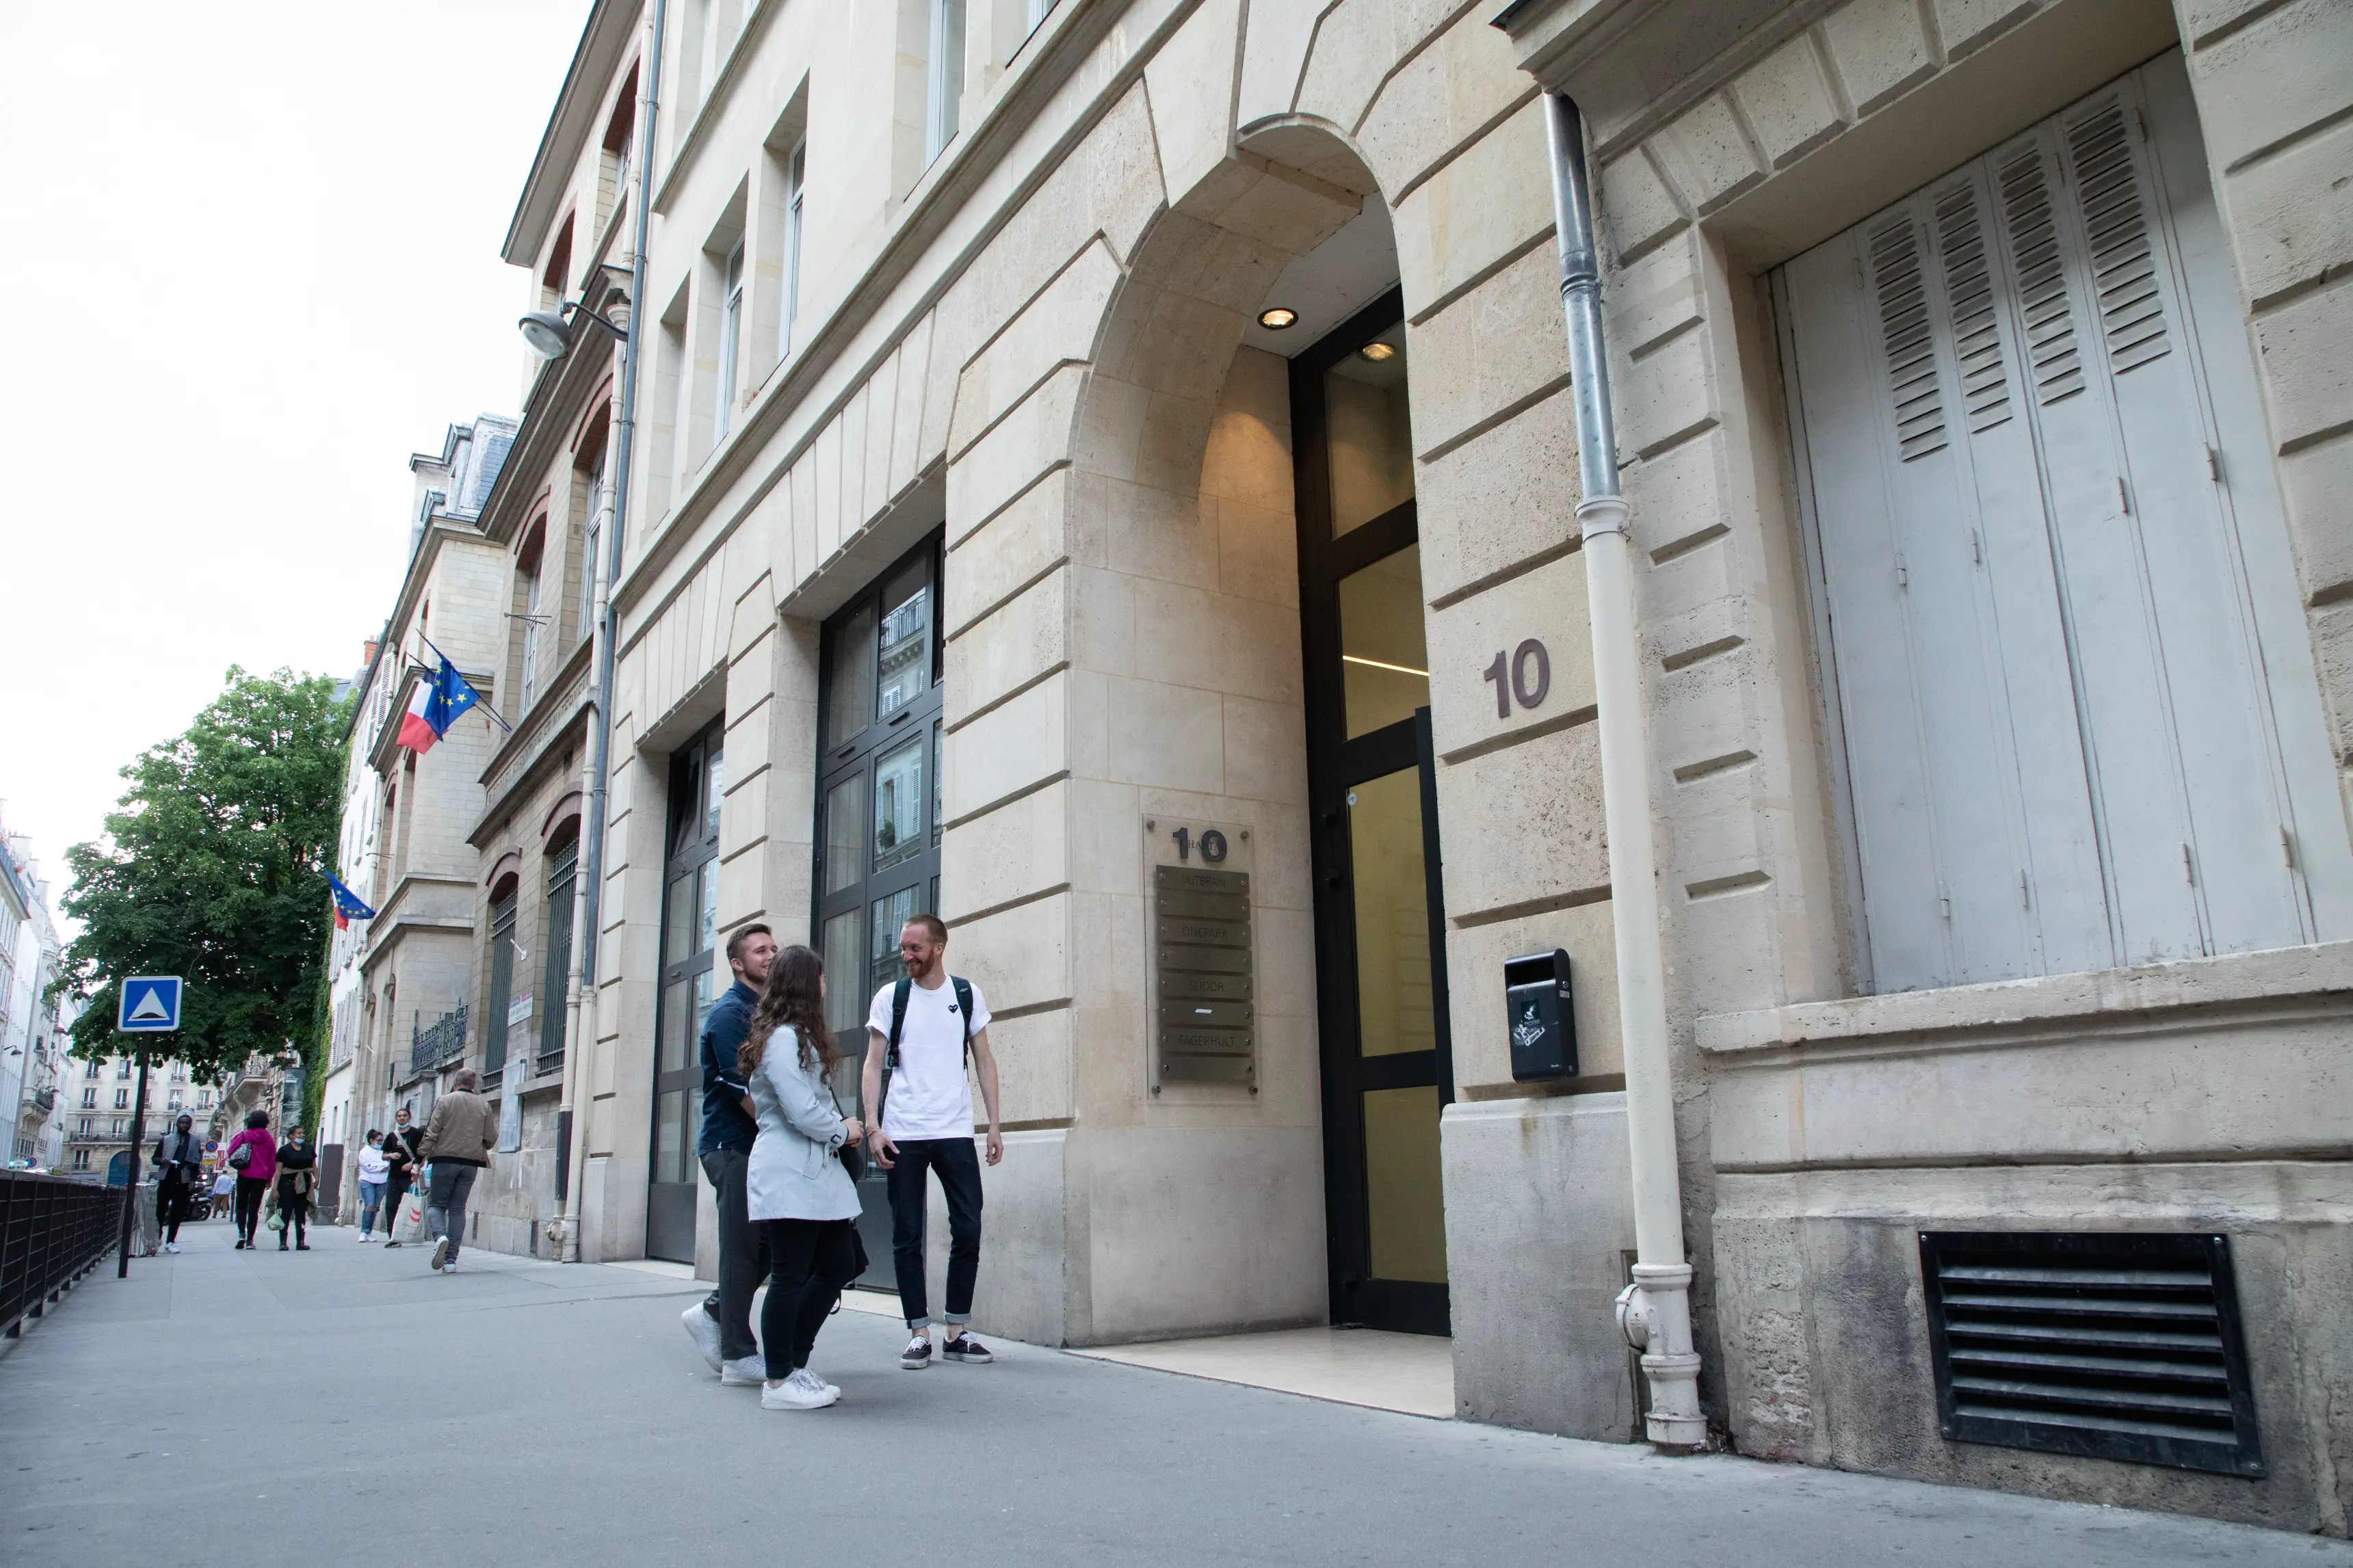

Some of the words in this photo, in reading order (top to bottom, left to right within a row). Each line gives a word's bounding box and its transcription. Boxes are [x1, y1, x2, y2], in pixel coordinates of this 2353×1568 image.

[1484, 639, 1550, 718] 10
[1172, 827, 1227, 862] 10
[1181, 875, 1226, 888] OUTBRAIN
[1183, 927, 1228, 939] ONEPARK
[1189, 980, 1224, 992] SLIDOR
[1179, 1035, 1235, 1047] FAGERHULT
